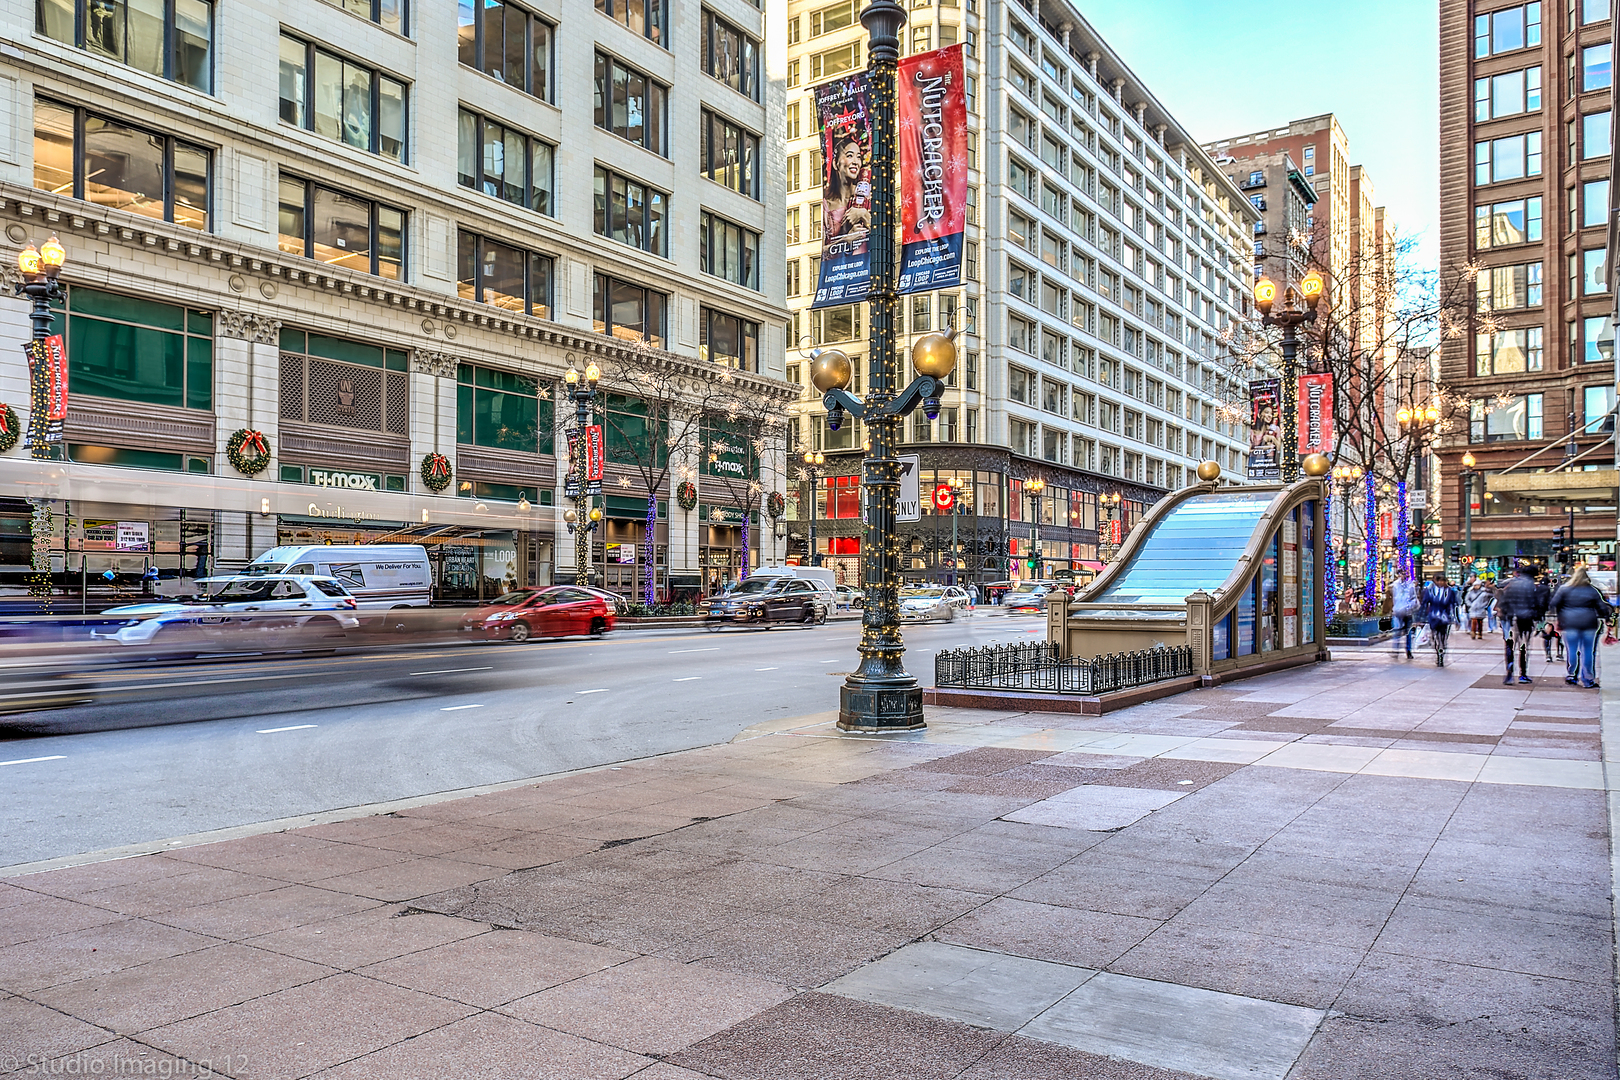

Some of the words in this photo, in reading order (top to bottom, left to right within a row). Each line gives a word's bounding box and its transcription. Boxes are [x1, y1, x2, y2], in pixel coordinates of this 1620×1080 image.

[818, 92, 841, 105] JOFFREY
[847, 84, 868, 97] BALLET
[826, 111, 866, 128] JOFFREY.ORG
[915, 71, 947, 230] NUTCRACKER
[829, 242, 850, 255] GTL
[915, 247, 931, 256] EXPLORE
[940, 243, 950, 251] LOOP
[832, 263, 848, 272] EXPLORE
[907, 252, 956, 268] LoopChicago.com
[824, 269, 869, 283] LoopChicago.com
[914, 274, 930, 283] LOOP
[50, 344, 62, 413] NUTCRACKER
[1306, 381, 1323, 449] NUTCRACKER
[589, 429, 600, 477] NUTCRACKER
[308, 502, 380, 524] Burlington
[494, 550, 516, 563] LOOP
